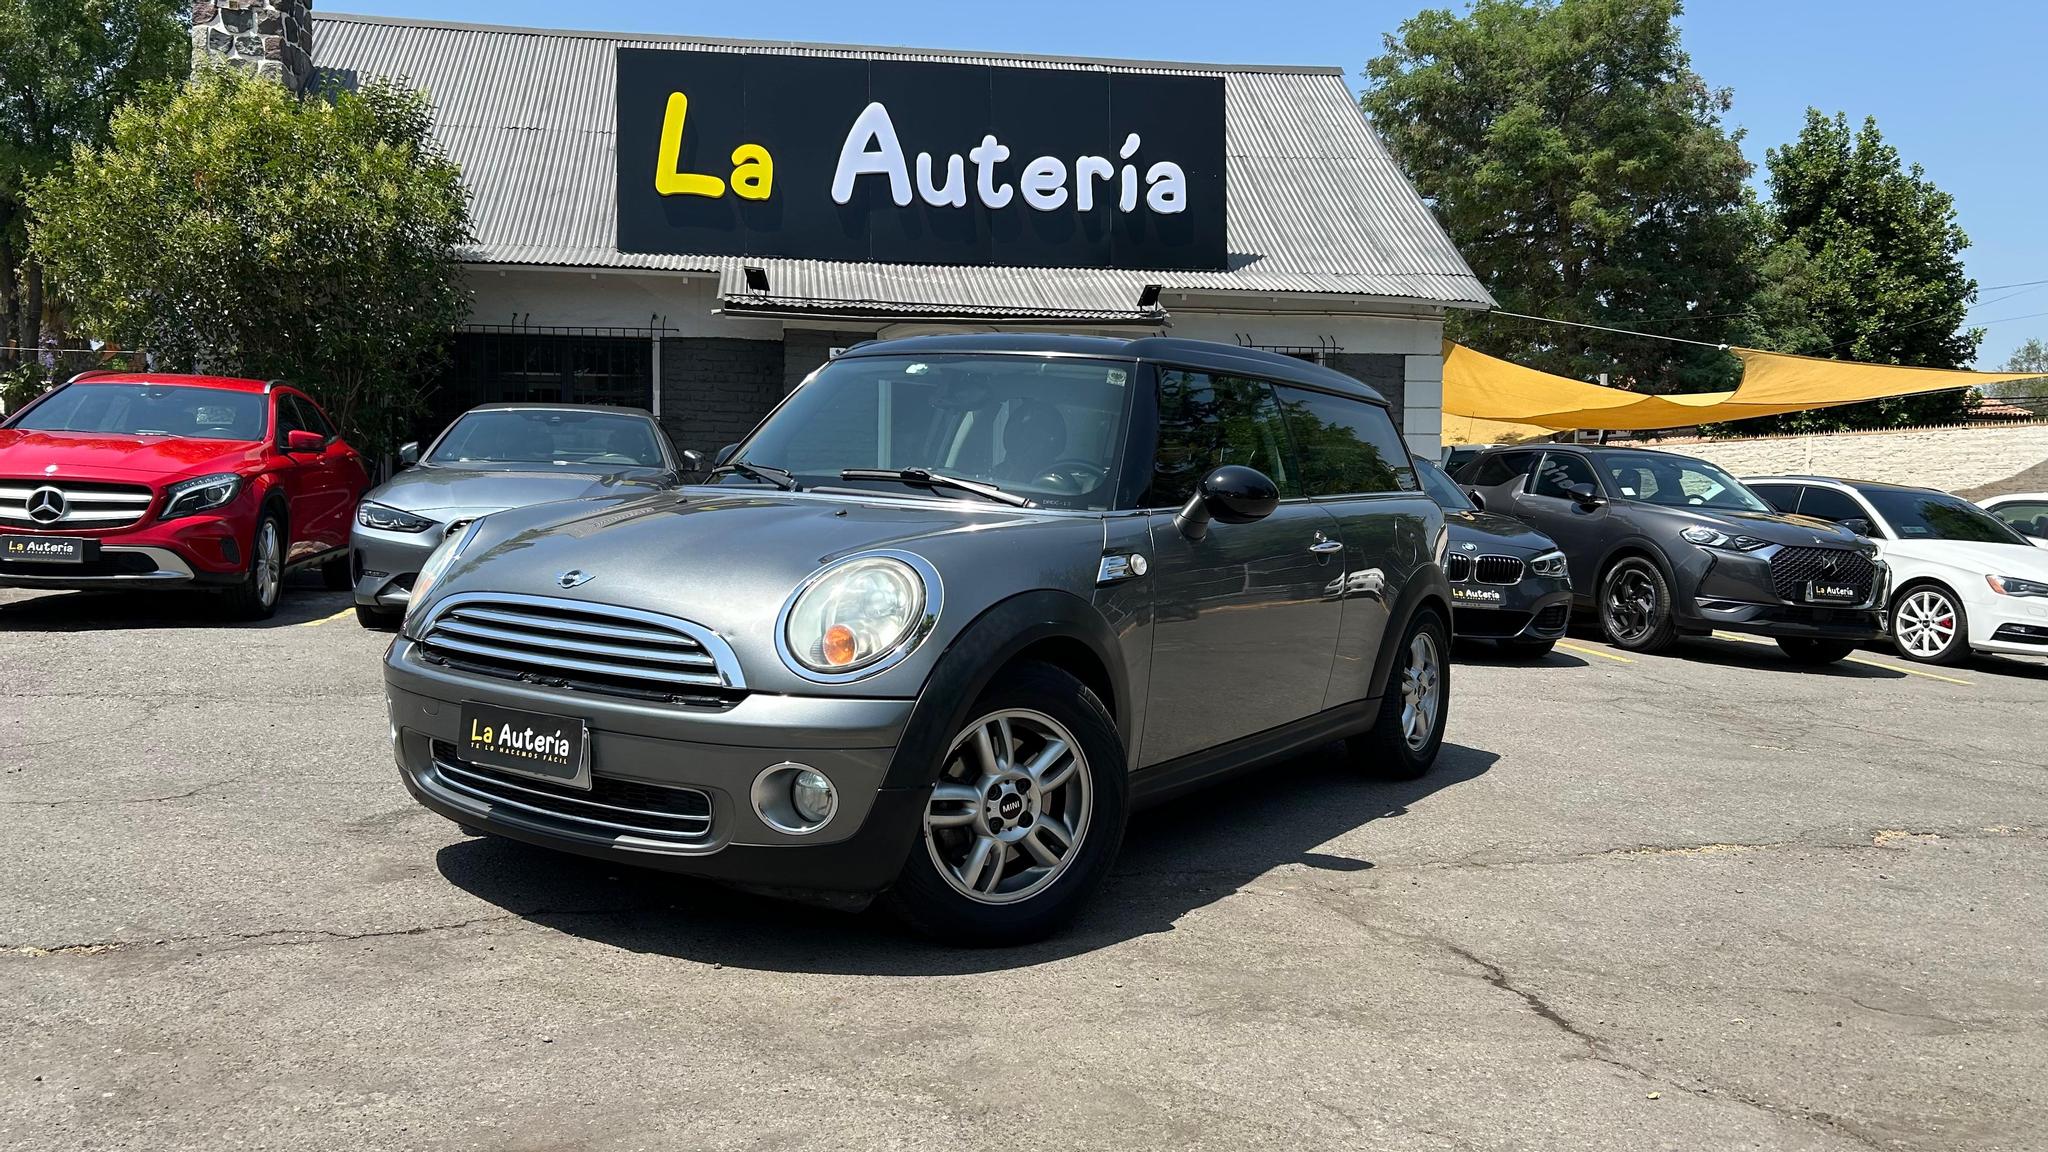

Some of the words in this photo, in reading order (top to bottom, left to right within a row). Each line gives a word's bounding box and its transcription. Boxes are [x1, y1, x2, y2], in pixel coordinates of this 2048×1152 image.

[655, 92, 774, 200] La
[831, 101, 1187, 214] Autería
[8, 540, 24, 550] La
[26, 542, 74, 552] Autería
[1452, 588, 1464, 596] La
[1816, 586, 1824, 594] La
[1826, 586, 1854, 596] Autería
[472, 718, 492, 744] La
[498, 724, 569, 756] Autería
[500, 747, 538, 759] HACEMOS
[542, 754, 568, 764] FÁCIL
[1002, 800, 1020, 812] MINI
